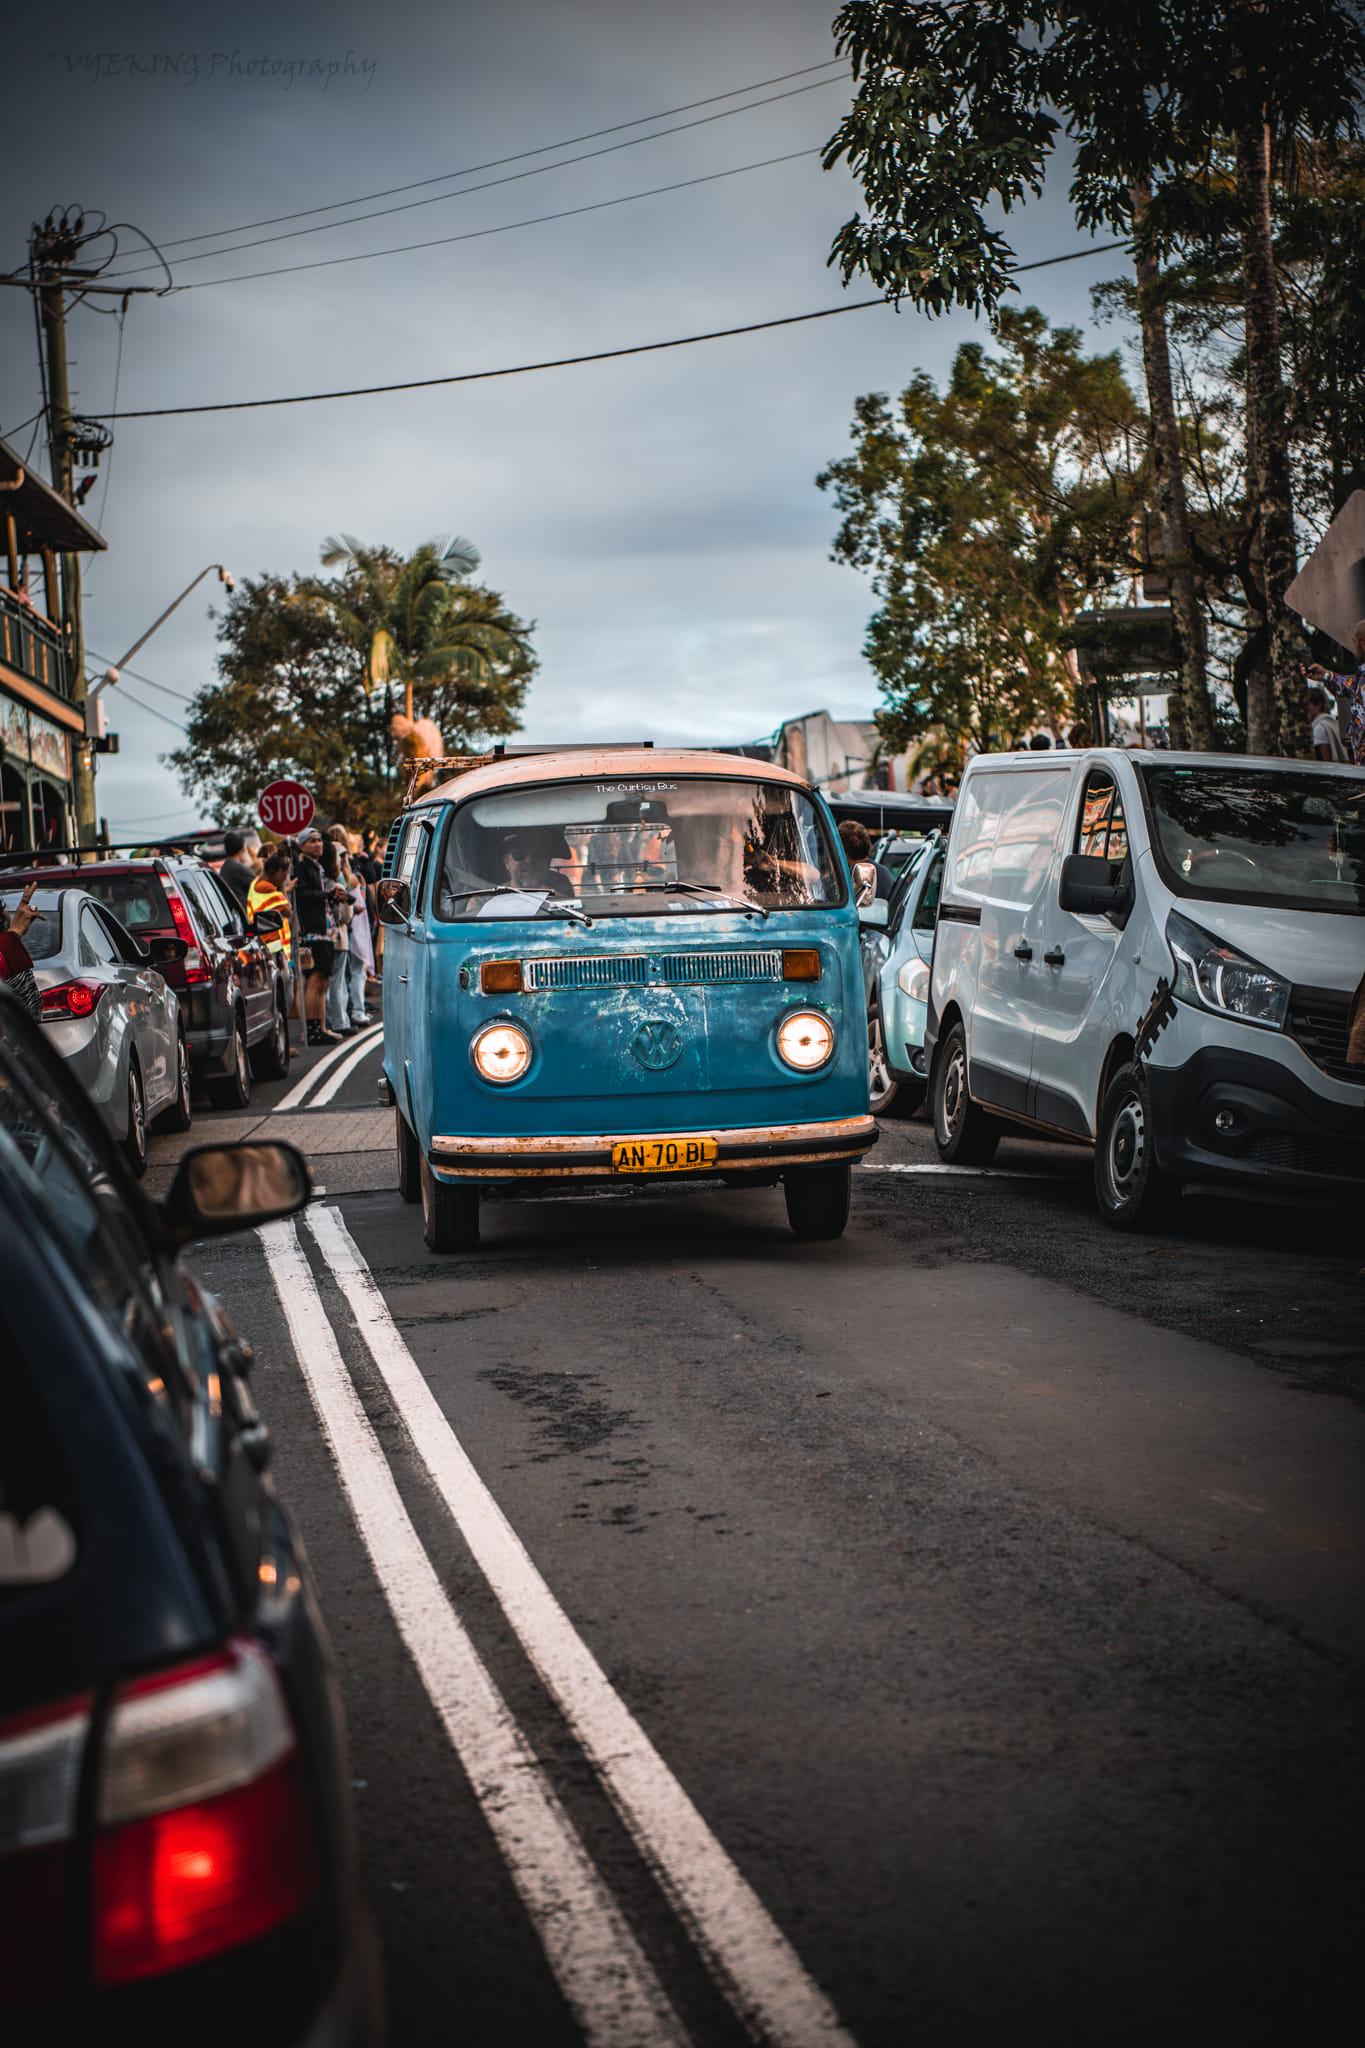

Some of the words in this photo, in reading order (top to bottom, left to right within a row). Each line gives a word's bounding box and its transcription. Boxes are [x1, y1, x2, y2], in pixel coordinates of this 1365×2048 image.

[594, 785, 616, 793] The
[657, 782, 679, 791] Bus
[261, 793, 310, 823] STOP
